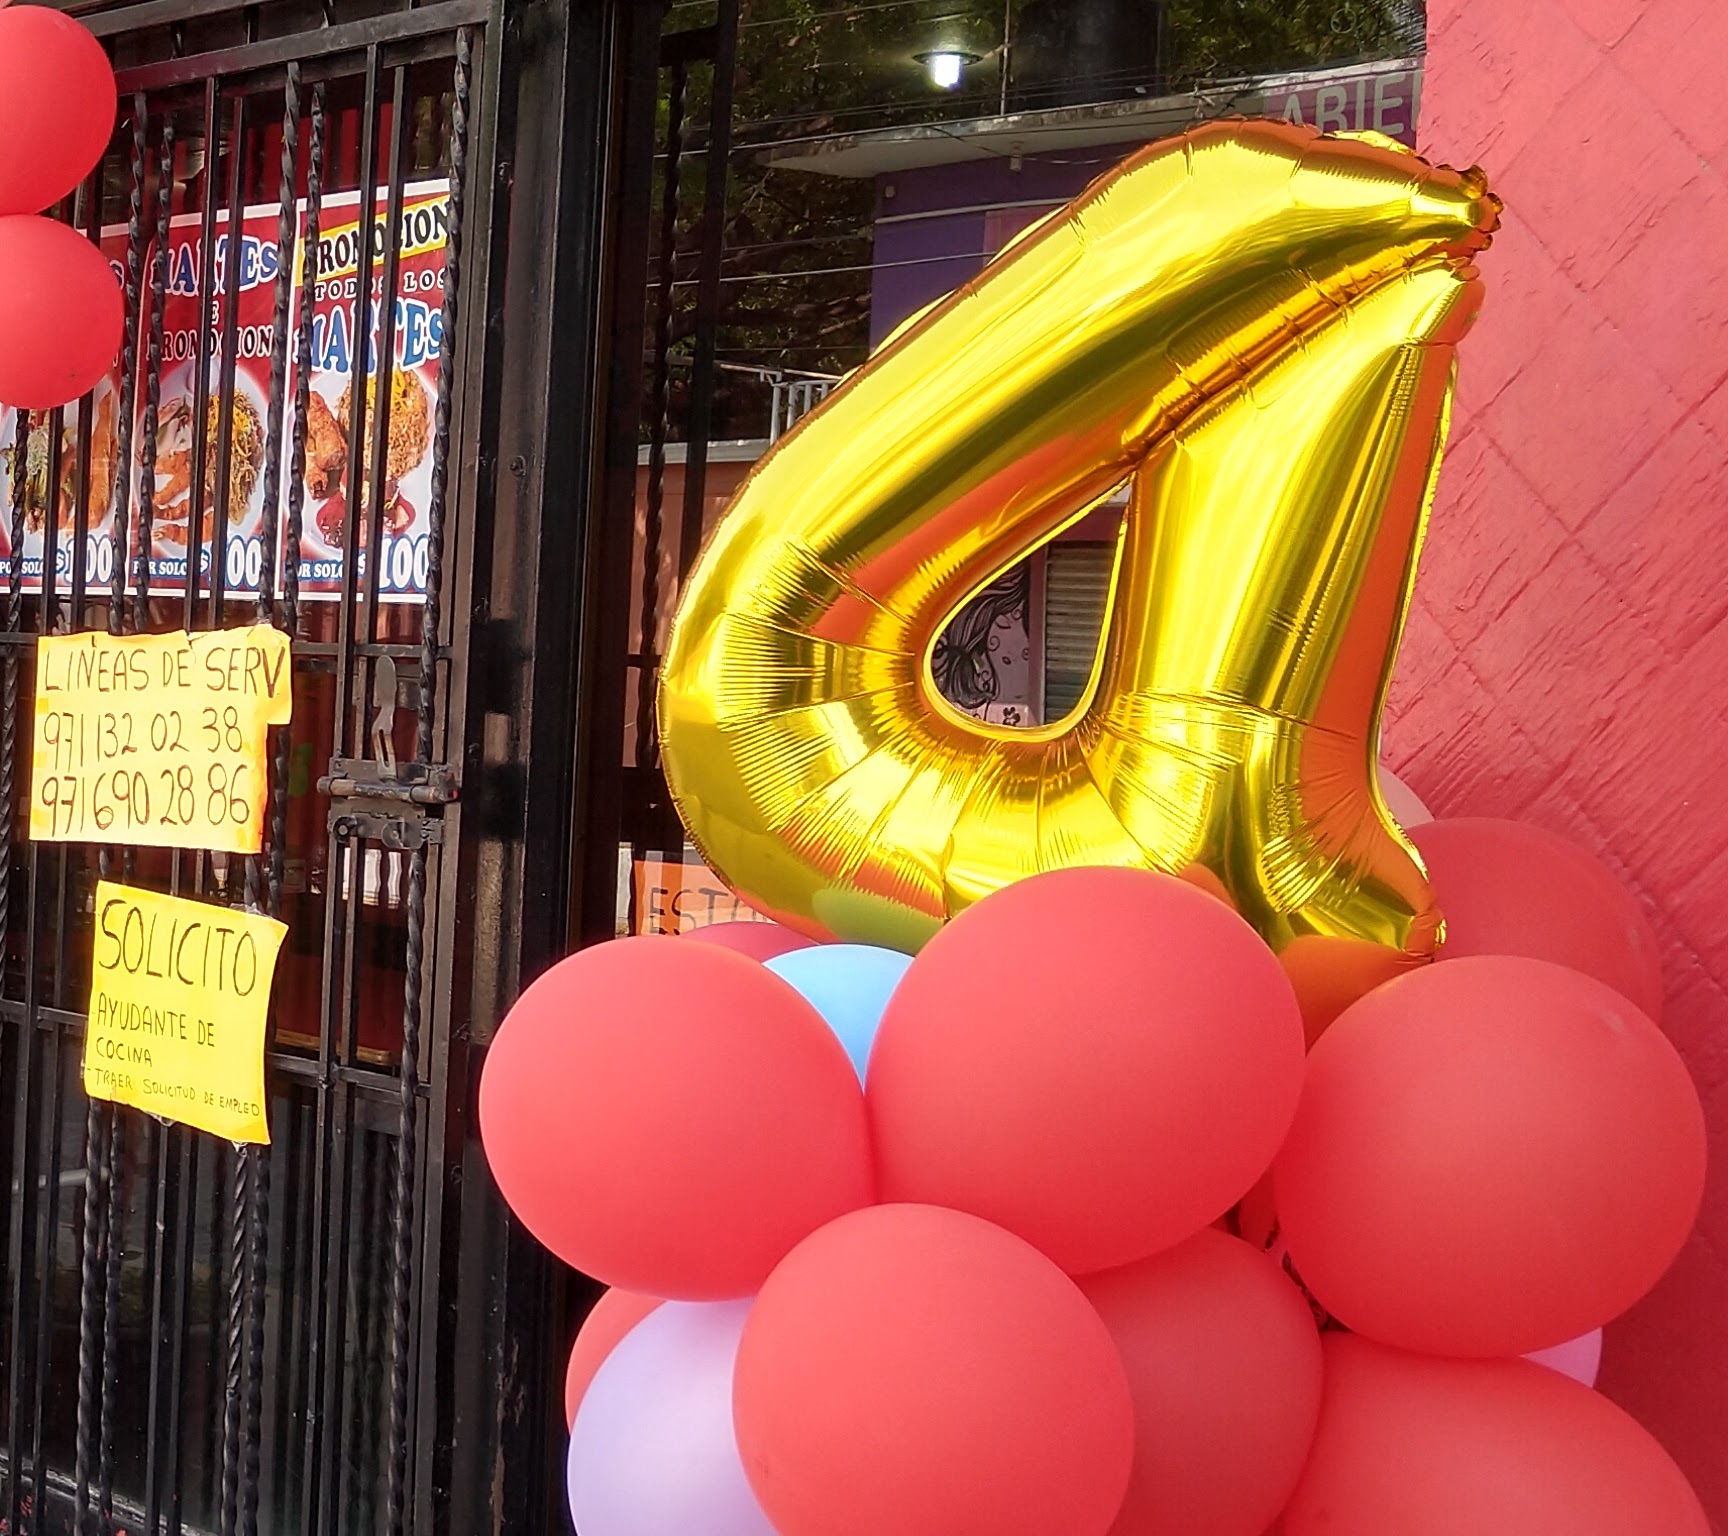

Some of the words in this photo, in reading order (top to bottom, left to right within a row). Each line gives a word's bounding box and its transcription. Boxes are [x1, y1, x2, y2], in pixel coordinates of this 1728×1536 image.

[1282, 72, 1422, 136] ABIE
[150, 233, 280, 298] ATES
[304, 201, 450, 276] ROOION
[147, 324, 274, 362] ROMOION
[293, 295, 444, 374] AES
[162, 649, 191, 688] DE
[205, 646, 286, 699] SERV
[150, 710, 190, 753] 02
[201, 705, 243, 754] 38
[159, 764, 195, 826] 28
[207, 762, 250, 826] 86
[98, 898, 257, 997] SOLICITO
[97, 991, 188, 1041] AYUDANTE
[197, 1019, 216, 1048] DE
[95, 1036, 153, 1068] COCINA
[142, 1078, 197, 1101] SOLICITUD
[203, 1090, 215, 1106] DE
[219, 1095, 260, 1117] EMPLEO
